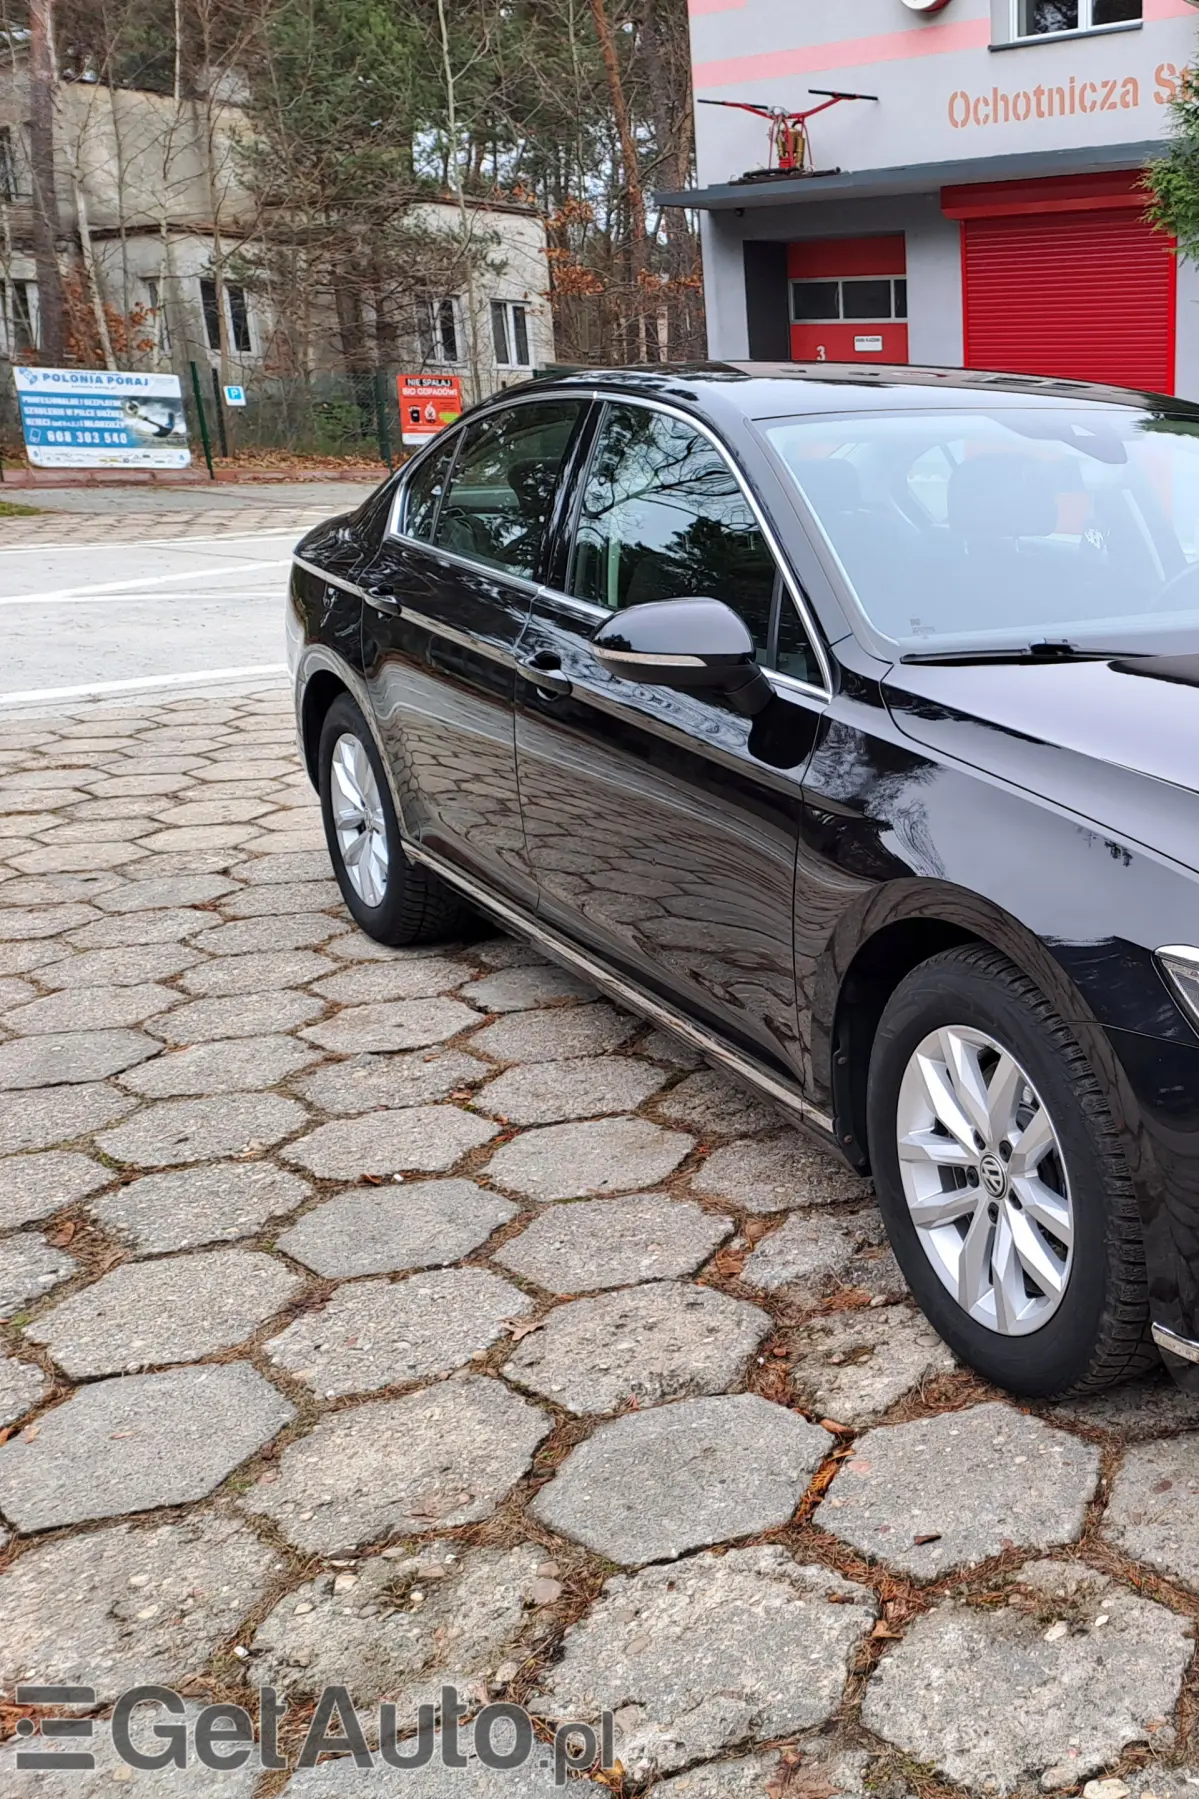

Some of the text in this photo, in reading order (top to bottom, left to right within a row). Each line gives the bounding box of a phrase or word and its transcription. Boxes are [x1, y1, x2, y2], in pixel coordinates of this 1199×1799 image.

[948, 76, 1139, 128] Ochotnicza
[816, 345, 826, 361] 3
[43, 373, 103, 384] POLONIA
[107, 376, 149, 386] PORAJ
[407, 378, 451, 387] NIE SPALAJ
